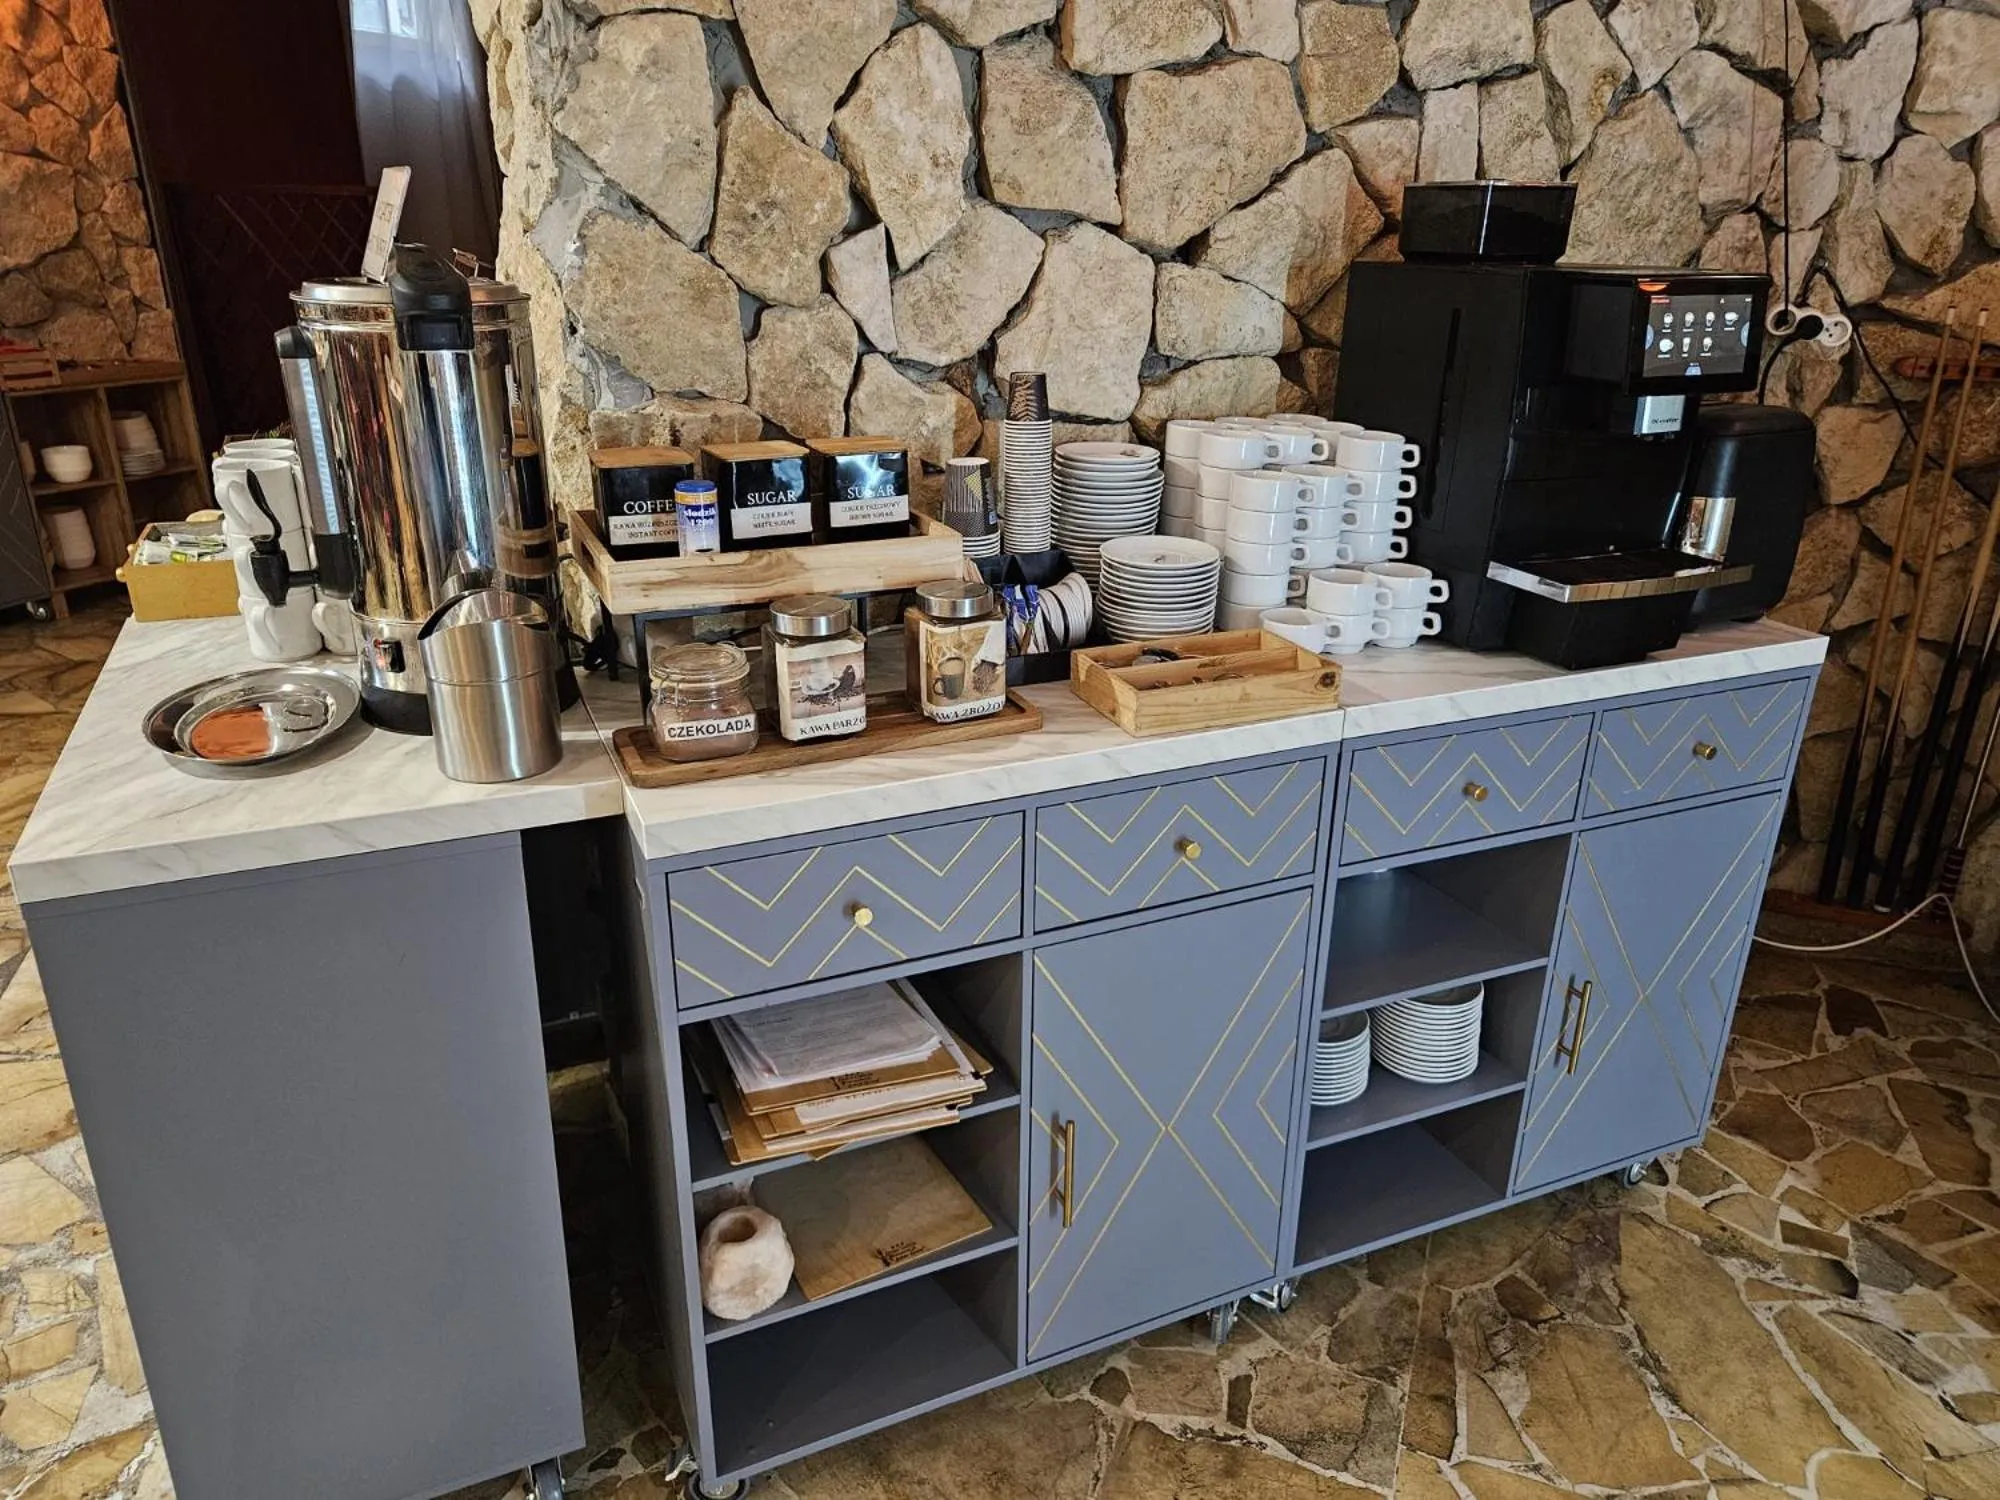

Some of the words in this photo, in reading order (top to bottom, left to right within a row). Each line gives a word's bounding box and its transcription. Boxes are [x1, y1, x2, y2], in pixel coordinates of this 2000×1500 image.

[747, 490, 797, 505] SUGAR
[623, 499, 674, 514] COFFE
[667, 719, 752, 738] CZEKOLADA
[799, 723, 831, 736] KAWA
